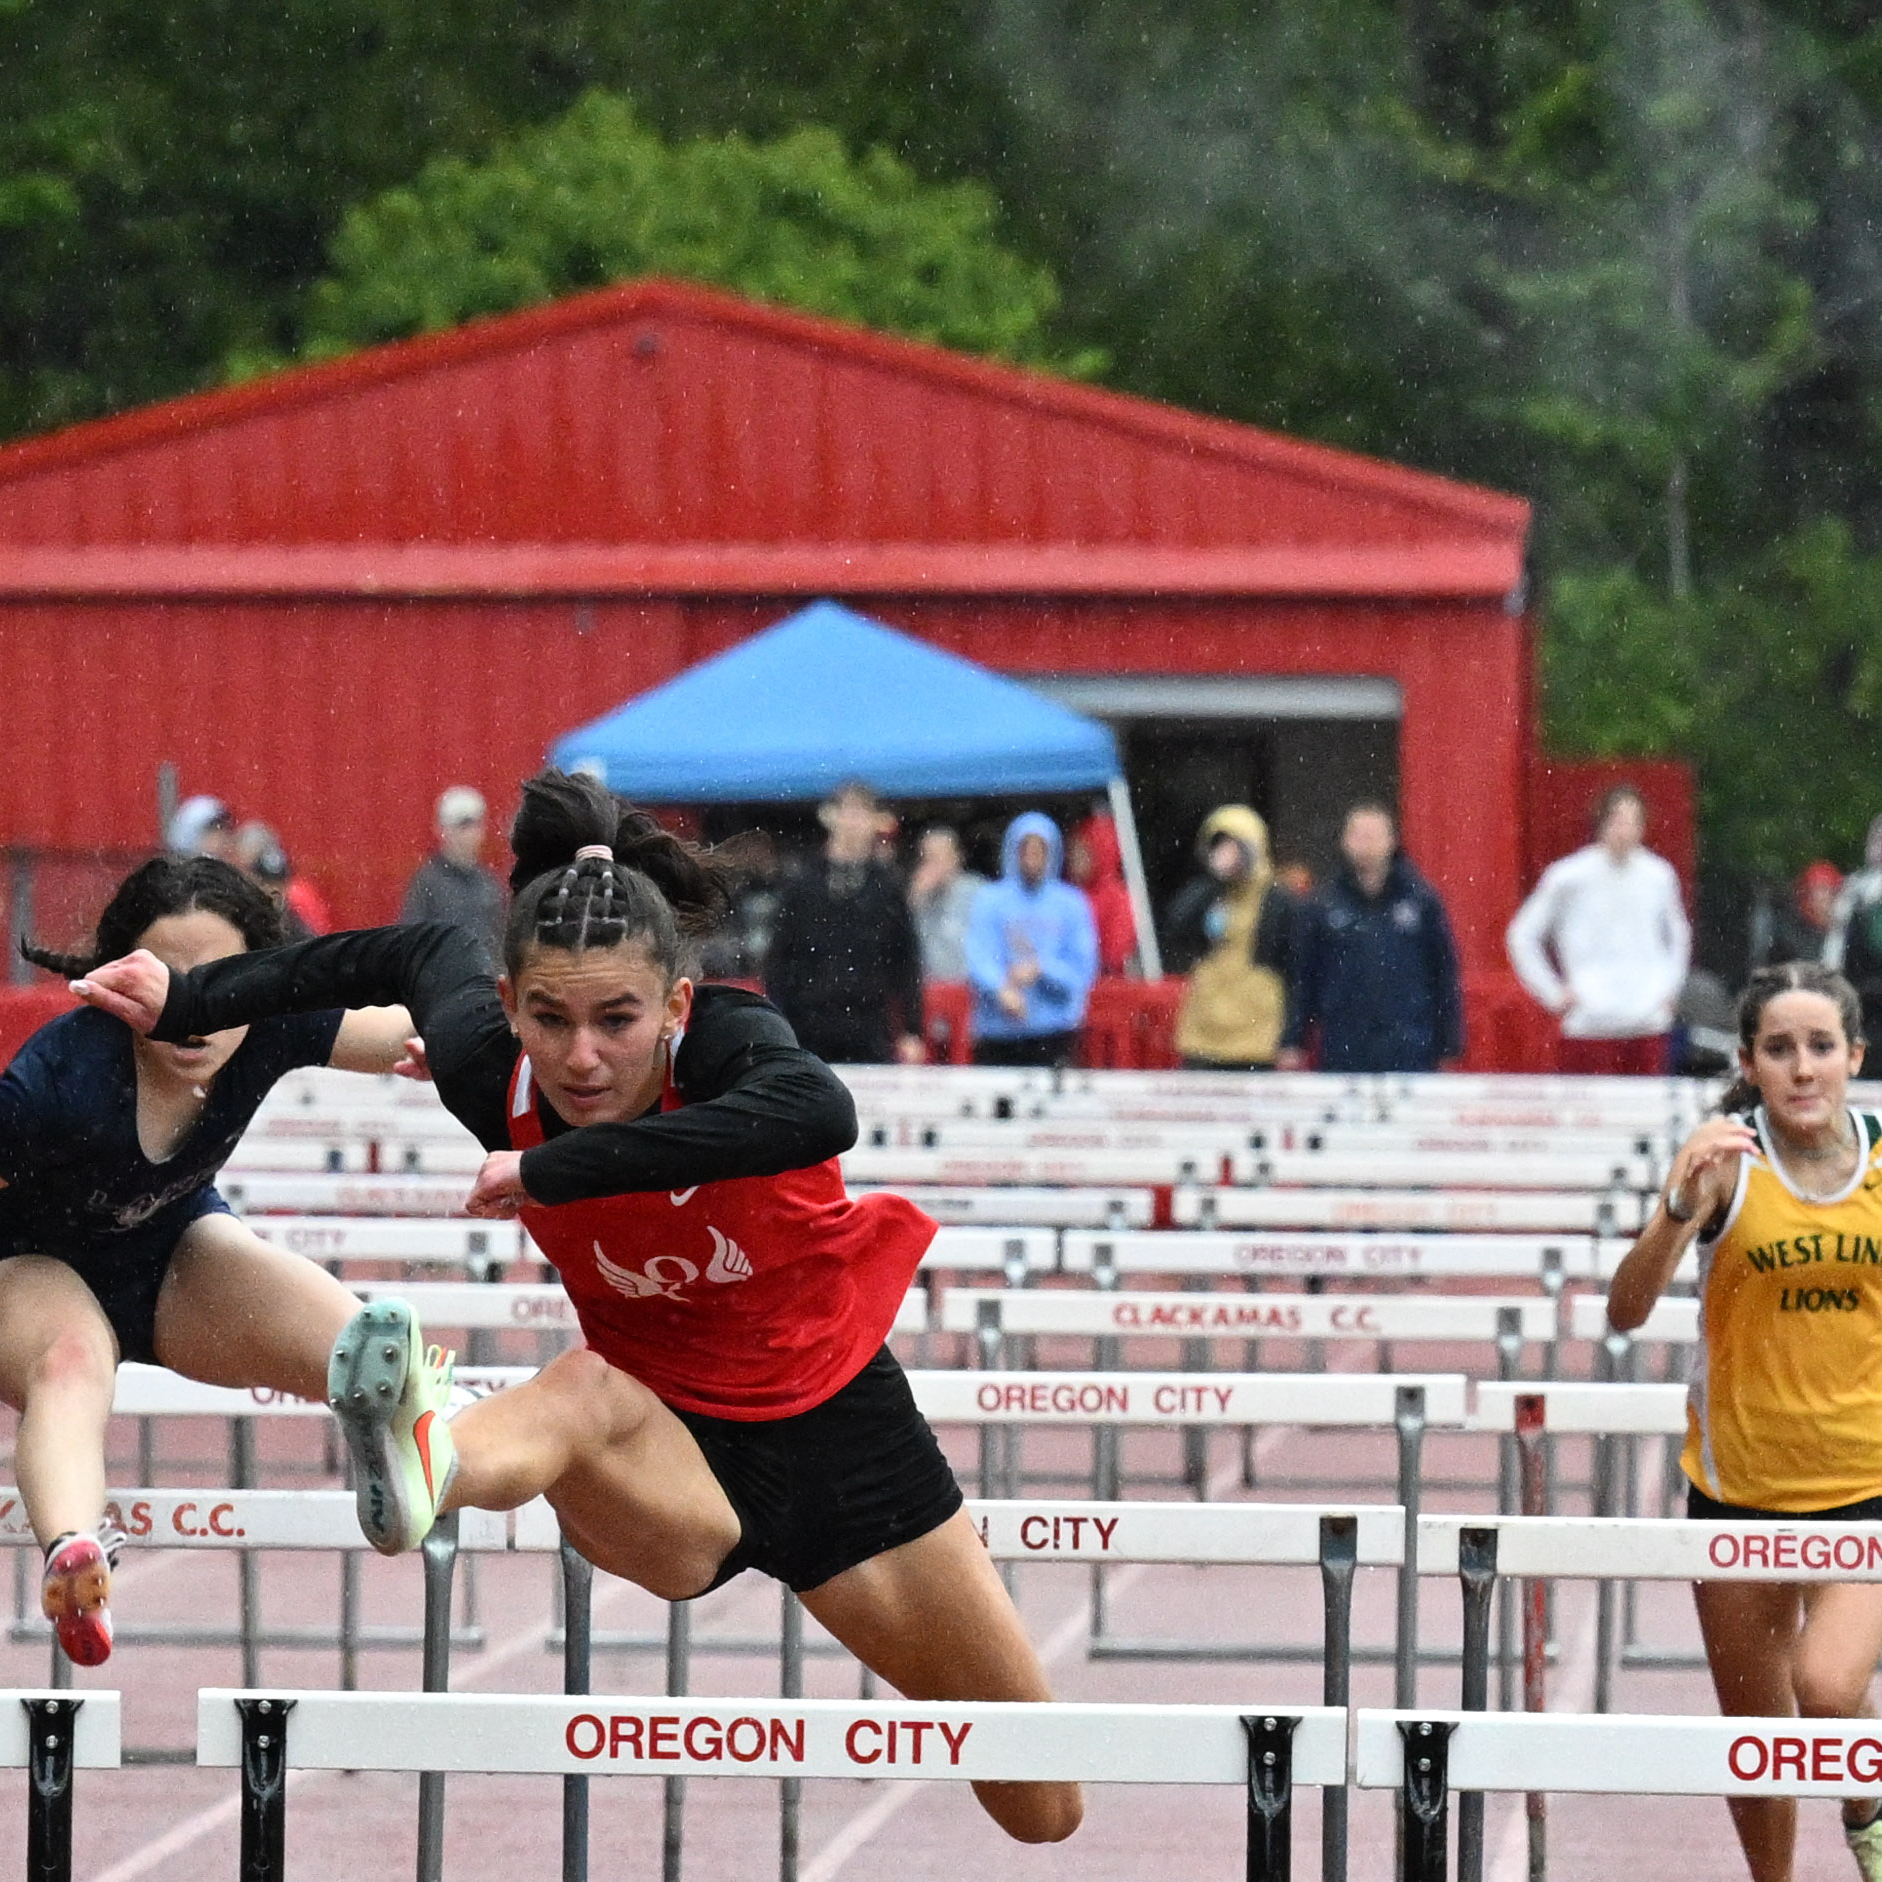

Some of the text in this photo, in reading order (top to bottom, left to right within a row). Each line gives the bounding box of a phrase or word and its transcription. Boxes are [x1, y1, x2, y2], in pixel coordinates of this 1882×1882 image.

[1746, 1234, 1824, 1273] WEST
[1113, 1304, 1302, 1331] CLACKAMAS
[1779, 1287, 1860, 1312] LIONS
[976, 1384, 1234, 1415] OREGON CITY
[171, 1502, 246, 1538] C.C.
[1020, 1515, 1120, 1551] CITY
[564, 1713, 973, 1766] OREGON CITY
